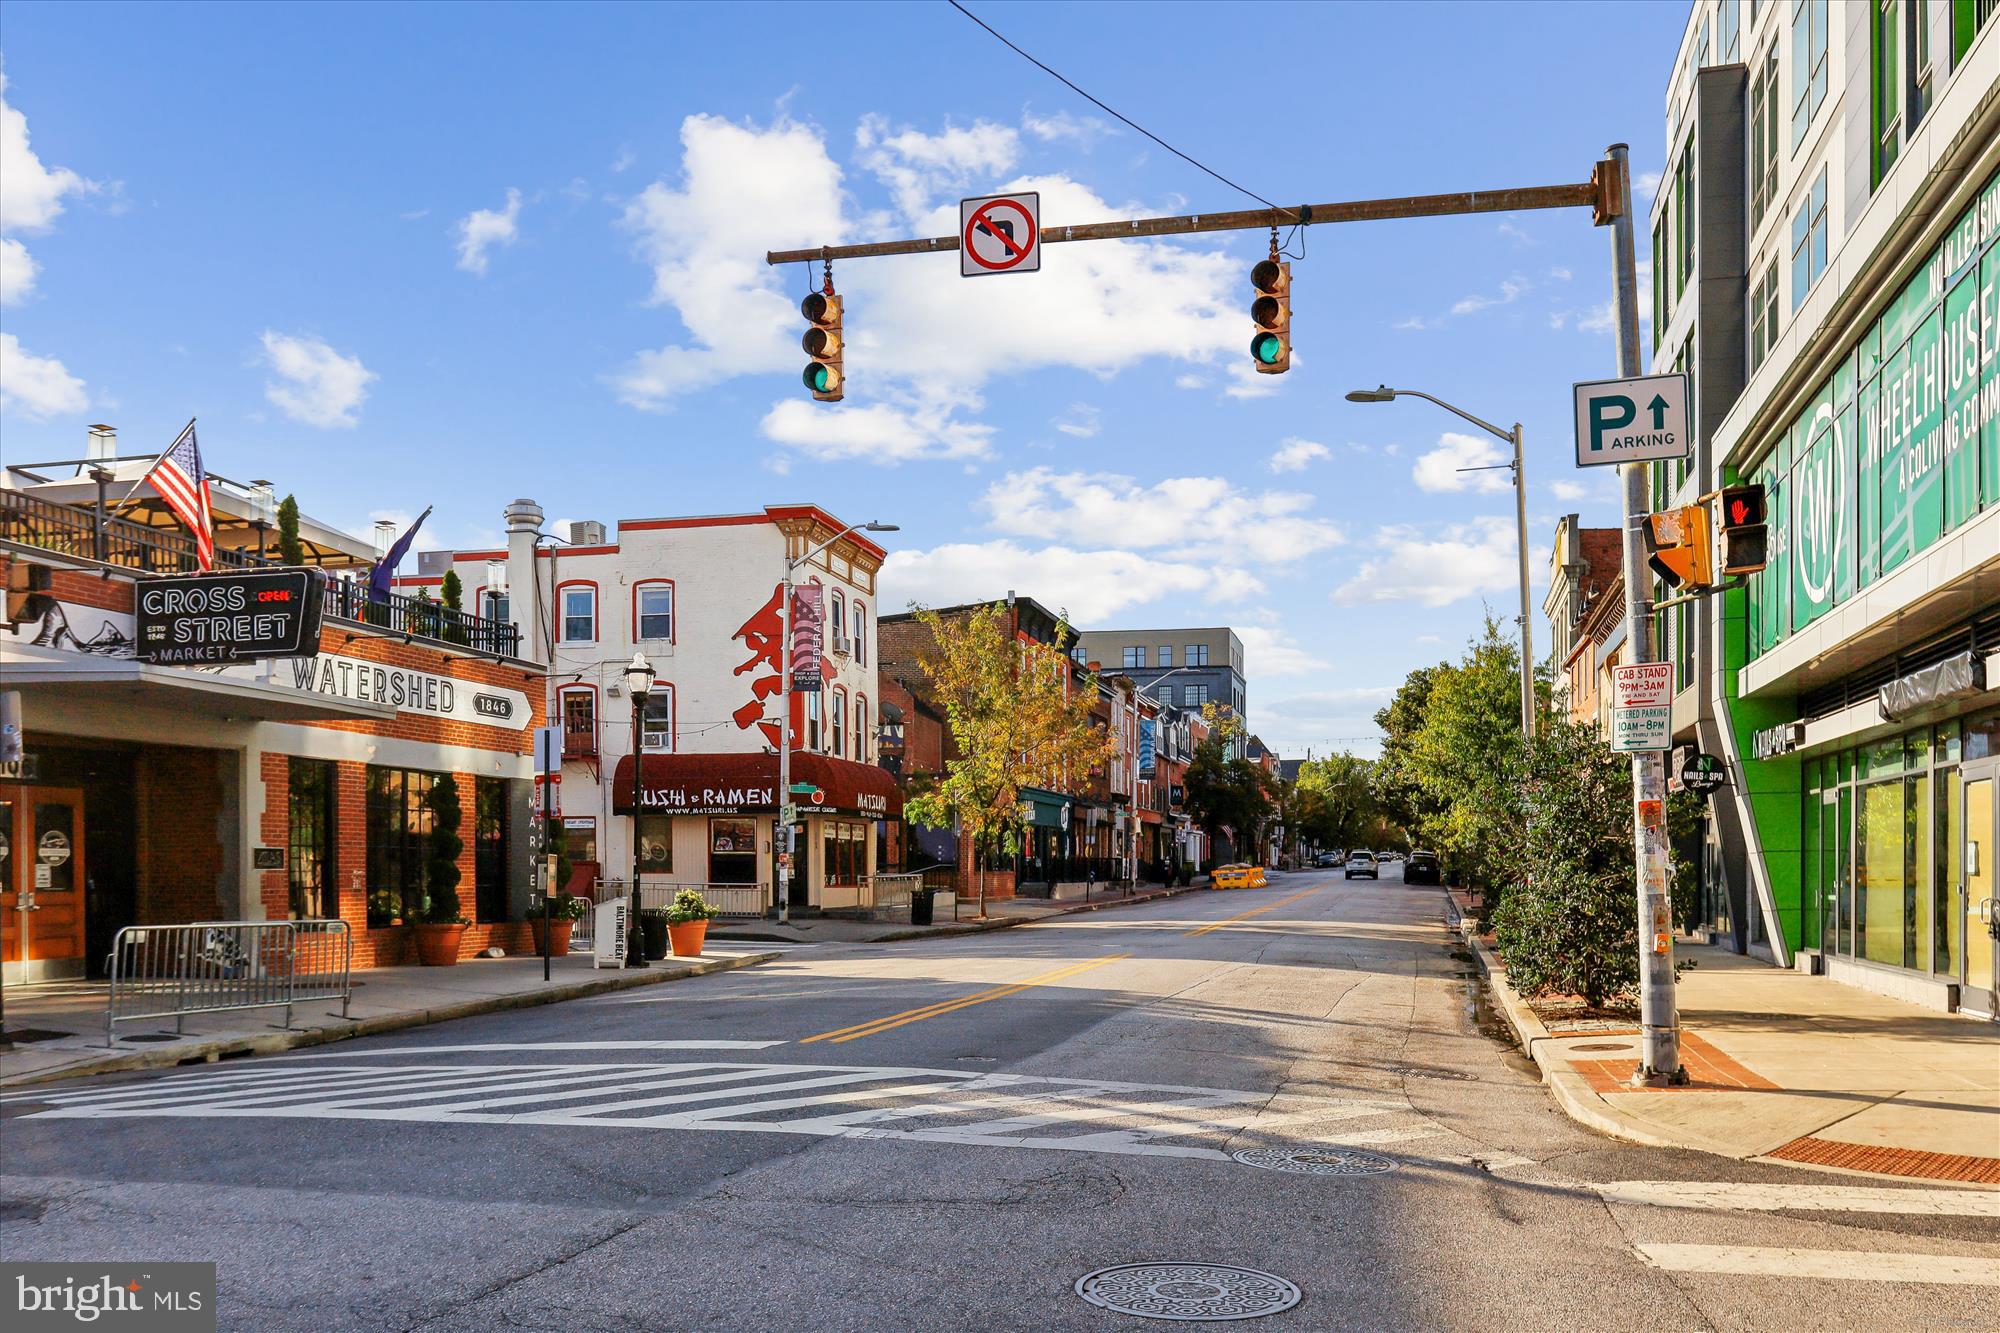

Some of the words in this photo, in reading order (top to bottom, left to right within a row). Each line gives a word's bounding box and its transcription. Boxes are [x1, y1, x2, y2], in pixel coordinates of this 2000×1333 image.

[1930, 239, 1954, 301] NOW
[1899, 457, 1906, 493] A
[1909, 410, 1959, 484] COLIVING
[143, 586, 246, 615] CROSS
[257, 590, 290, 602] OPEN
[813, 592, 822, 615] HILL
[174, 613, 291, 643] STREET
[160, 645, 226, 662] MARKET
[812, 616, 821, 669] FEDERAL
[292, 657, 454, 713] WATERSHED
[480, 698, 506, 714] 1846
[1618, 669, 1635, 681] CAB
[1637, 667, 1668, 679] STAND
[1616, 709, 1640, 719] METERED
[1641, 708, 1668, 718] PARKING
[1683, 771, 1704, 780] NAILS
[1709, 772, 1724, 782] SPA
[703, 787, 773, 806] RAMEN
[528, 797, 536, 905] MARKET
[616, 906, 625, 943] BALTIMORE
[614, 944, 624, 960] BEAT
